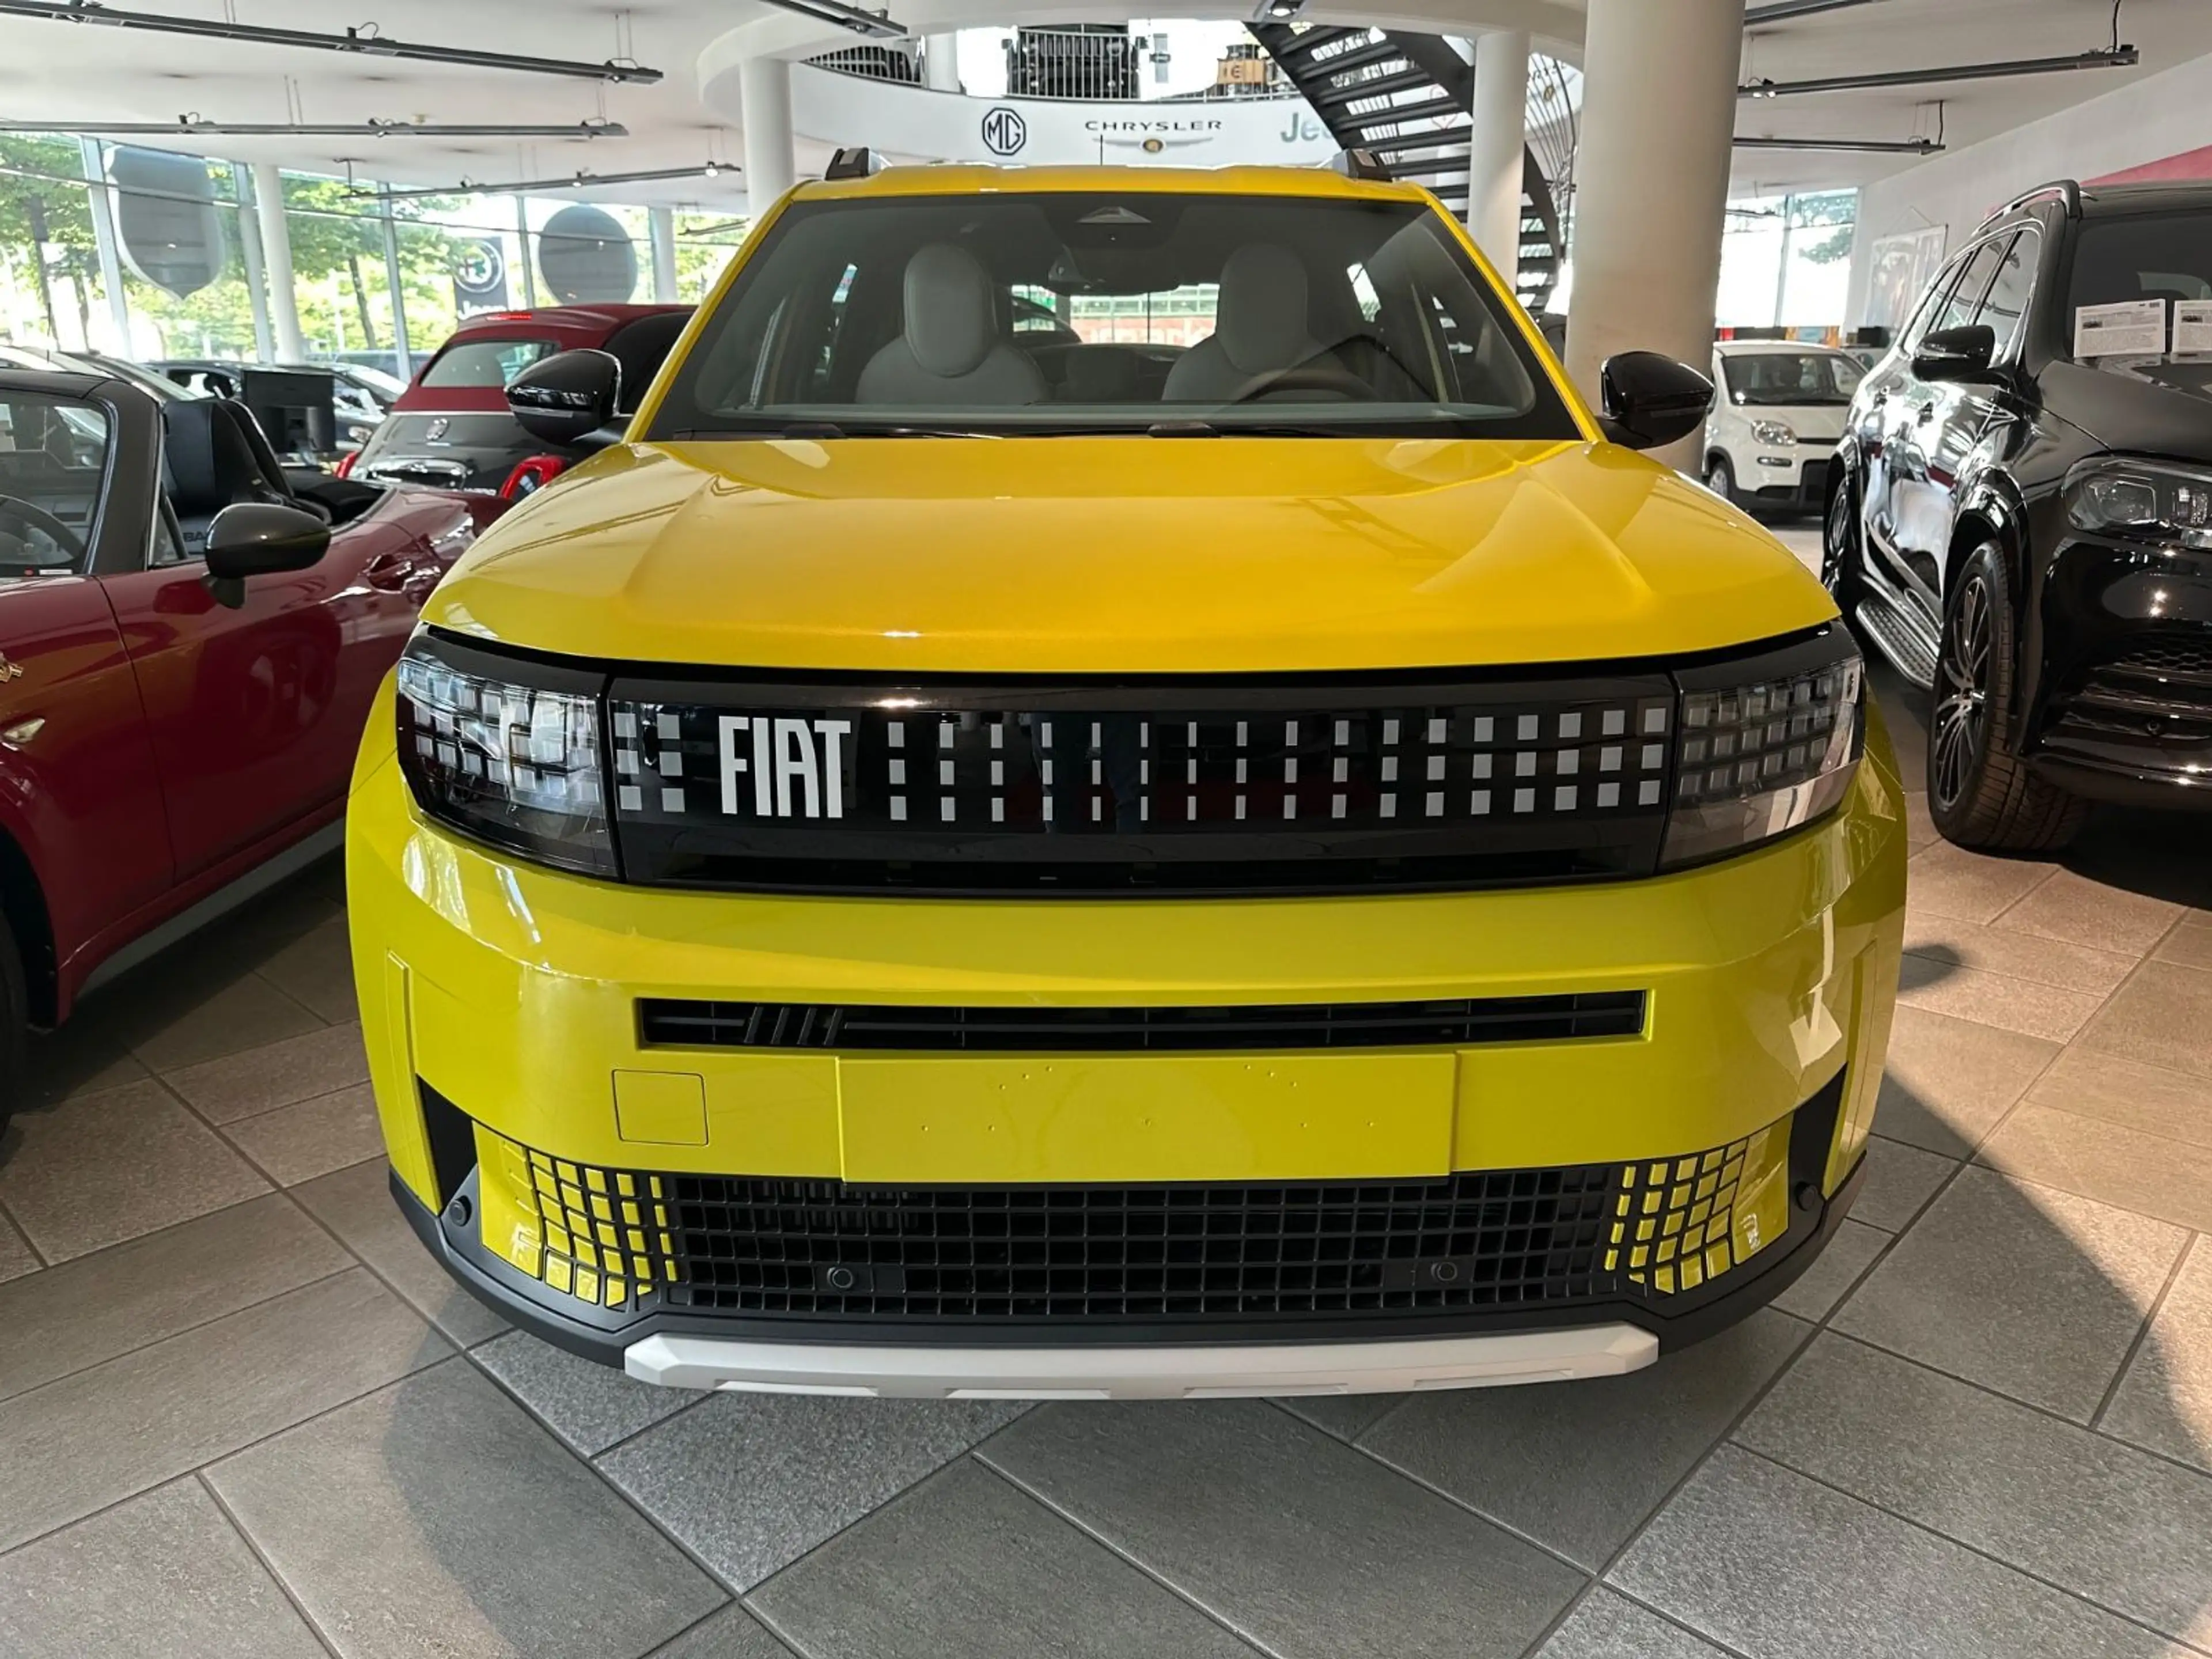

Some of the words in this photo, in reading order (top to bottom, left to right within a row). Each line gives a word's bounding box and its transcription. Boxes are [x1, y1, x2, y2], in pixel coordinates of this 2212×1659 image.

[987, 113, 1021, 150] MG
[1085, 120, 1222, 131] CHRYSLER
[719, 716, 851, 818] FIAT
